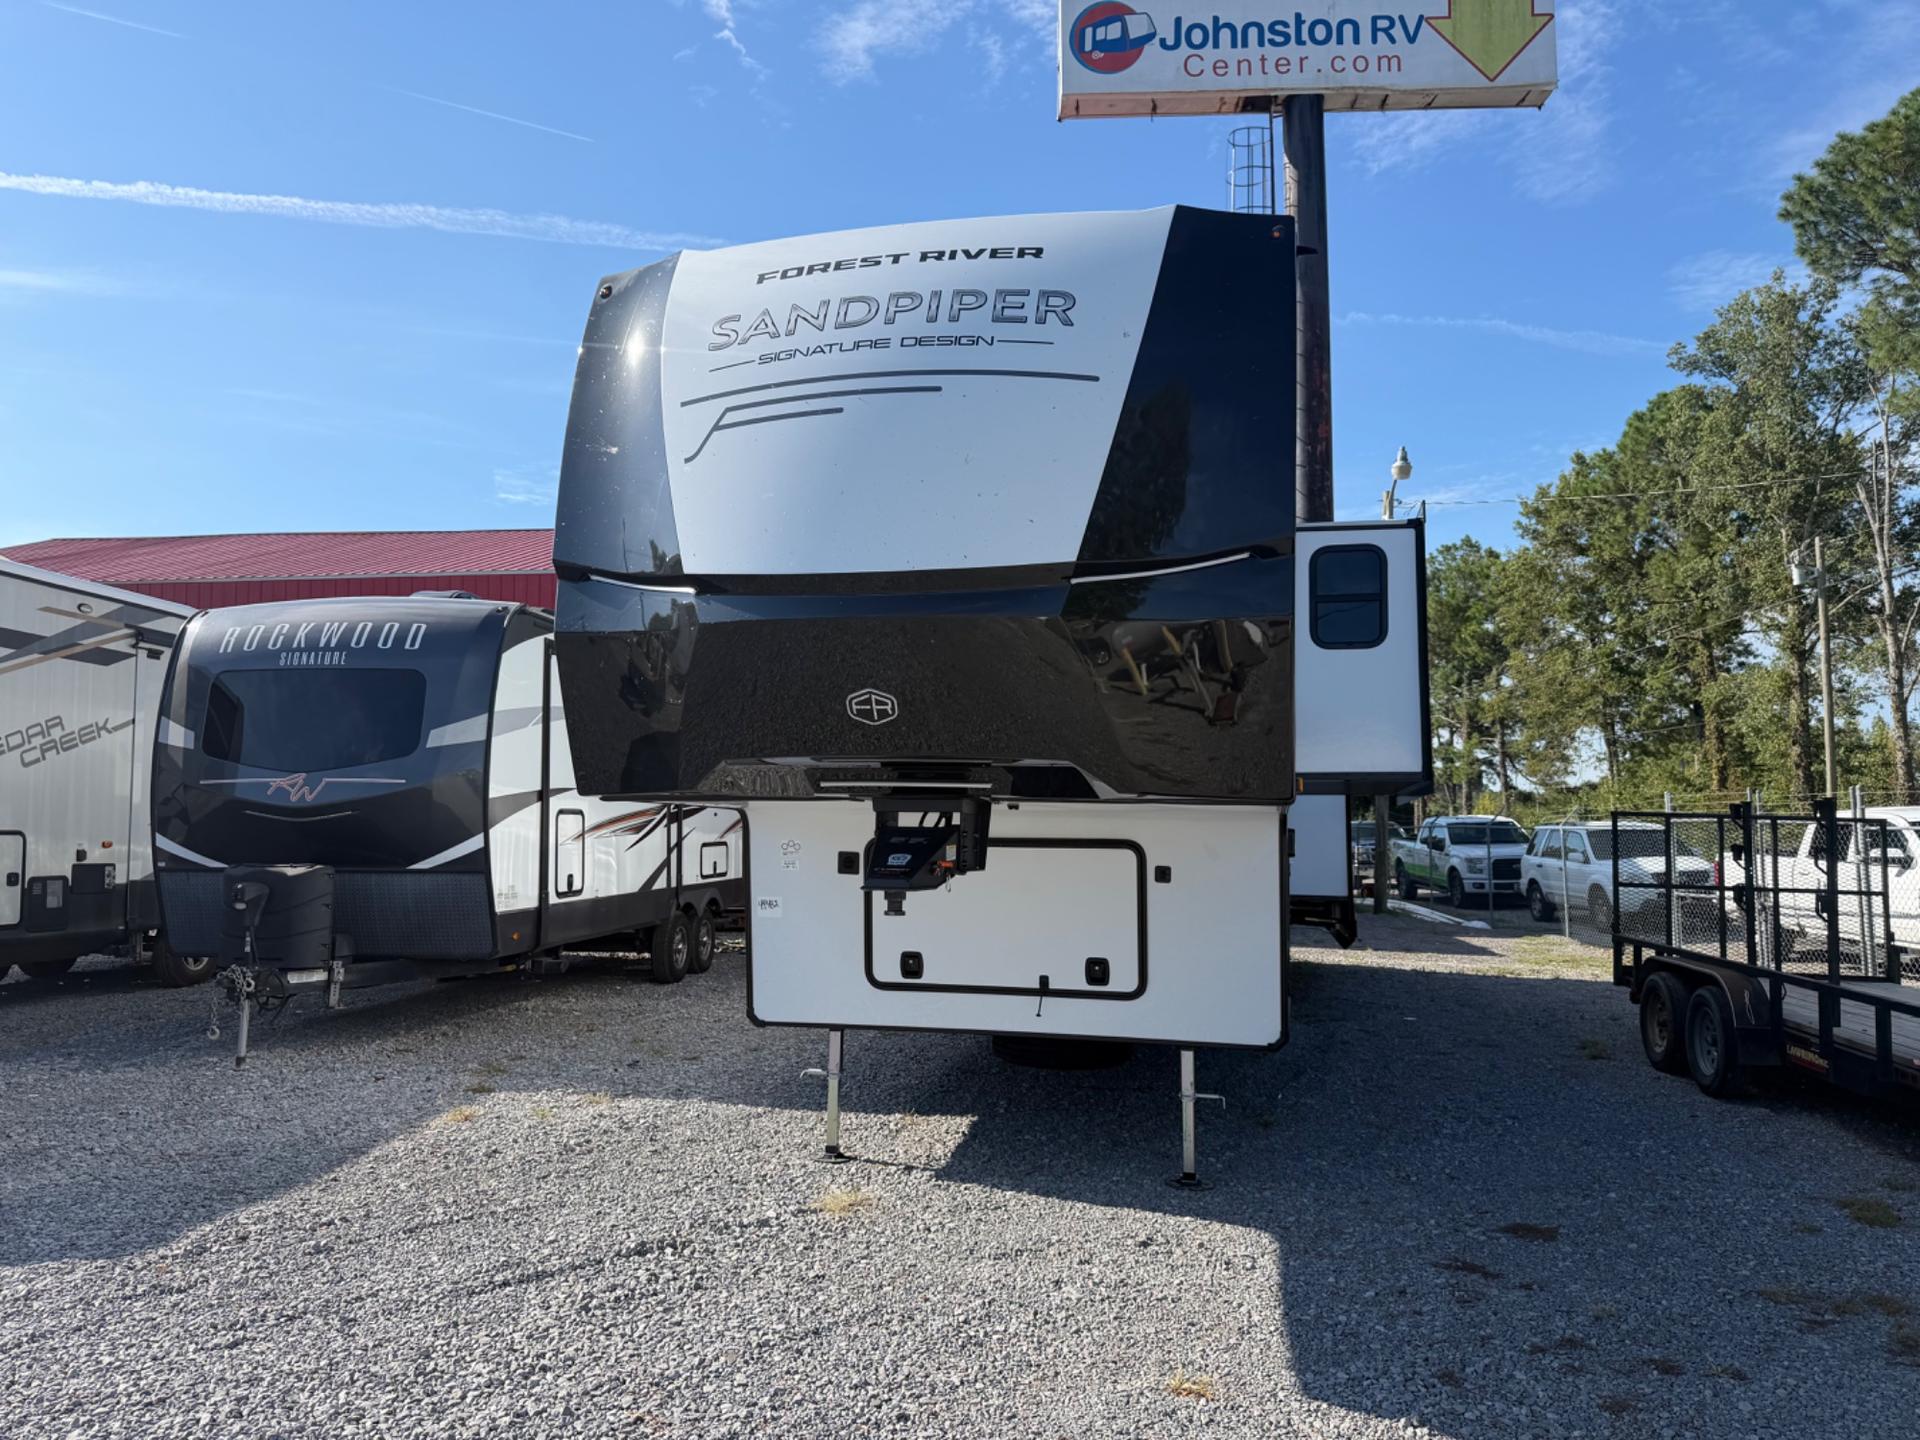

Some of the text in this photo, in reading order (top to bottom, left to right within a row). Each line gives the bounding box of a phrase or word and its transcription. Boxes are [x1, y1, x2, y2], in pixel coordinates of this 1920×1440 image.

[1159, 12, 1425, 51] Johnston RV
[1183, 51, 1402, 78] Center.com
[756, 246, 1044, 285] FOREST RIVER
[708, 288, 1077, 351] SANDPIPER
[758, 335, 995, 365] SIGNATURE DESIGN
[219, 622, 427, 653] ROCKWOOD
[279, 651, 349, 666] SIGNATURE
[19, 717, 113, 768] CREEK
